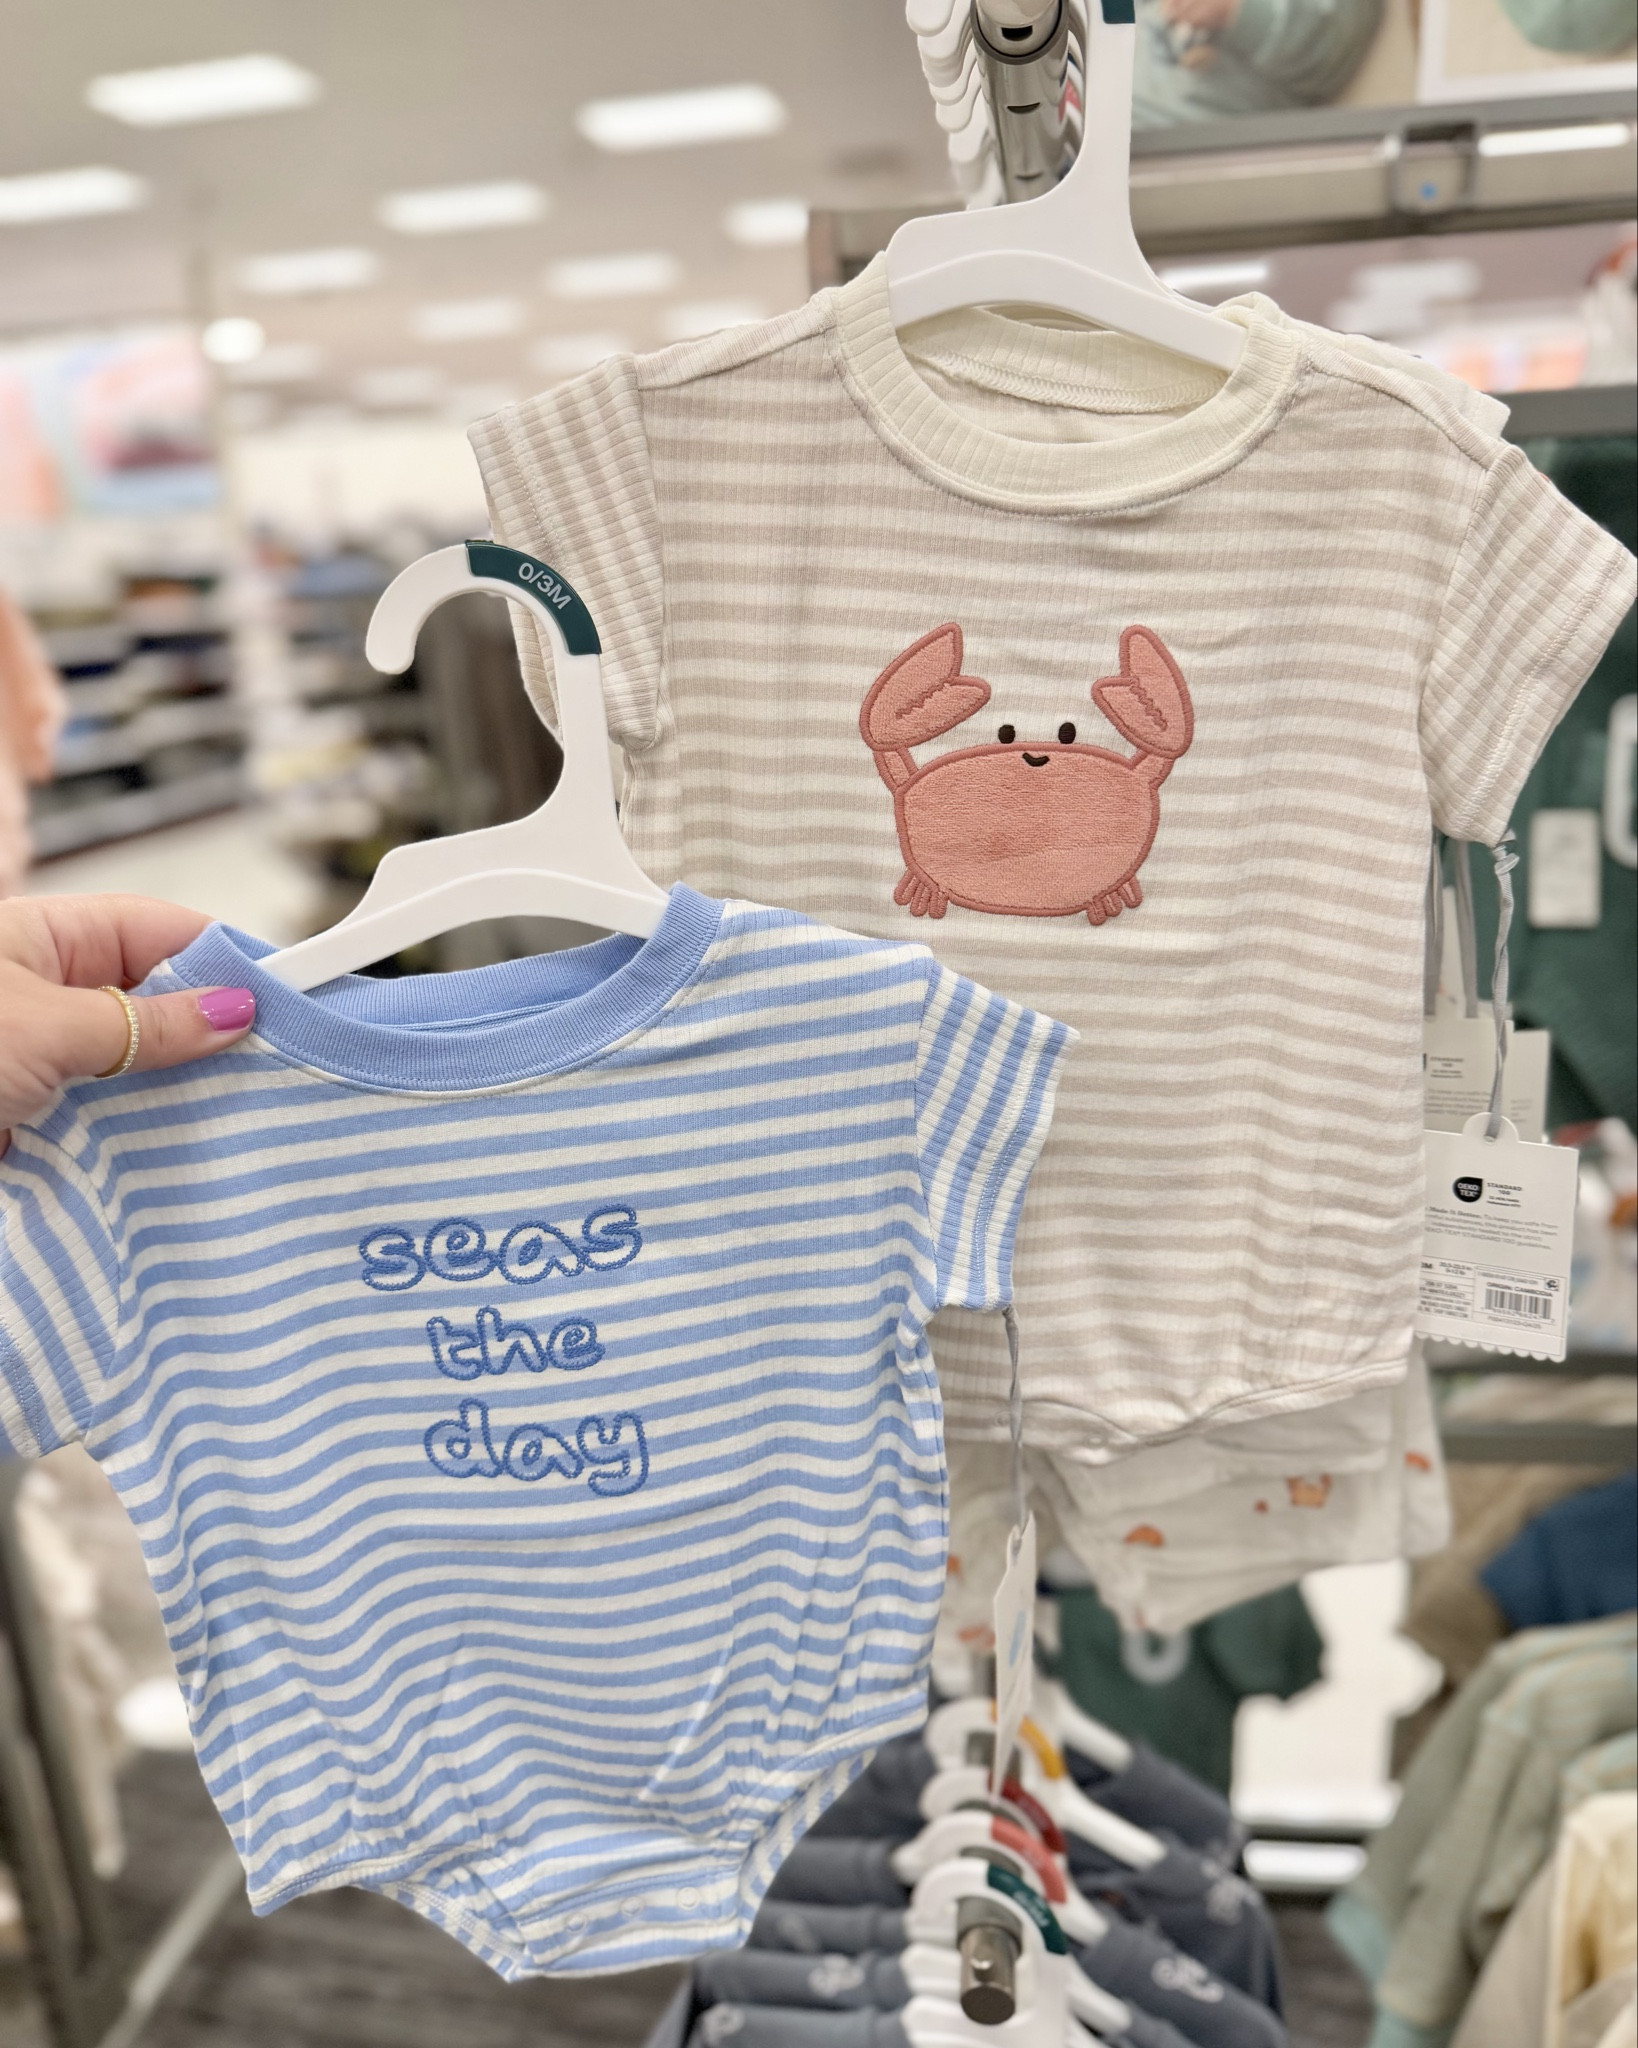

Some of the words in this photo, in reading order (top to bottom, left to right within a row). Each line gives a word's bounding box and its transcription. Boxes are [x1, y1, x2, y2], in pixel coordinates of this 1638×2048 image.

[518, 562, 572, 610] 0/3M
[359, 1203, 643, 1291] seas
[426, 1305, 606, 1381] the
[424, 1398, 650, 1497] day
